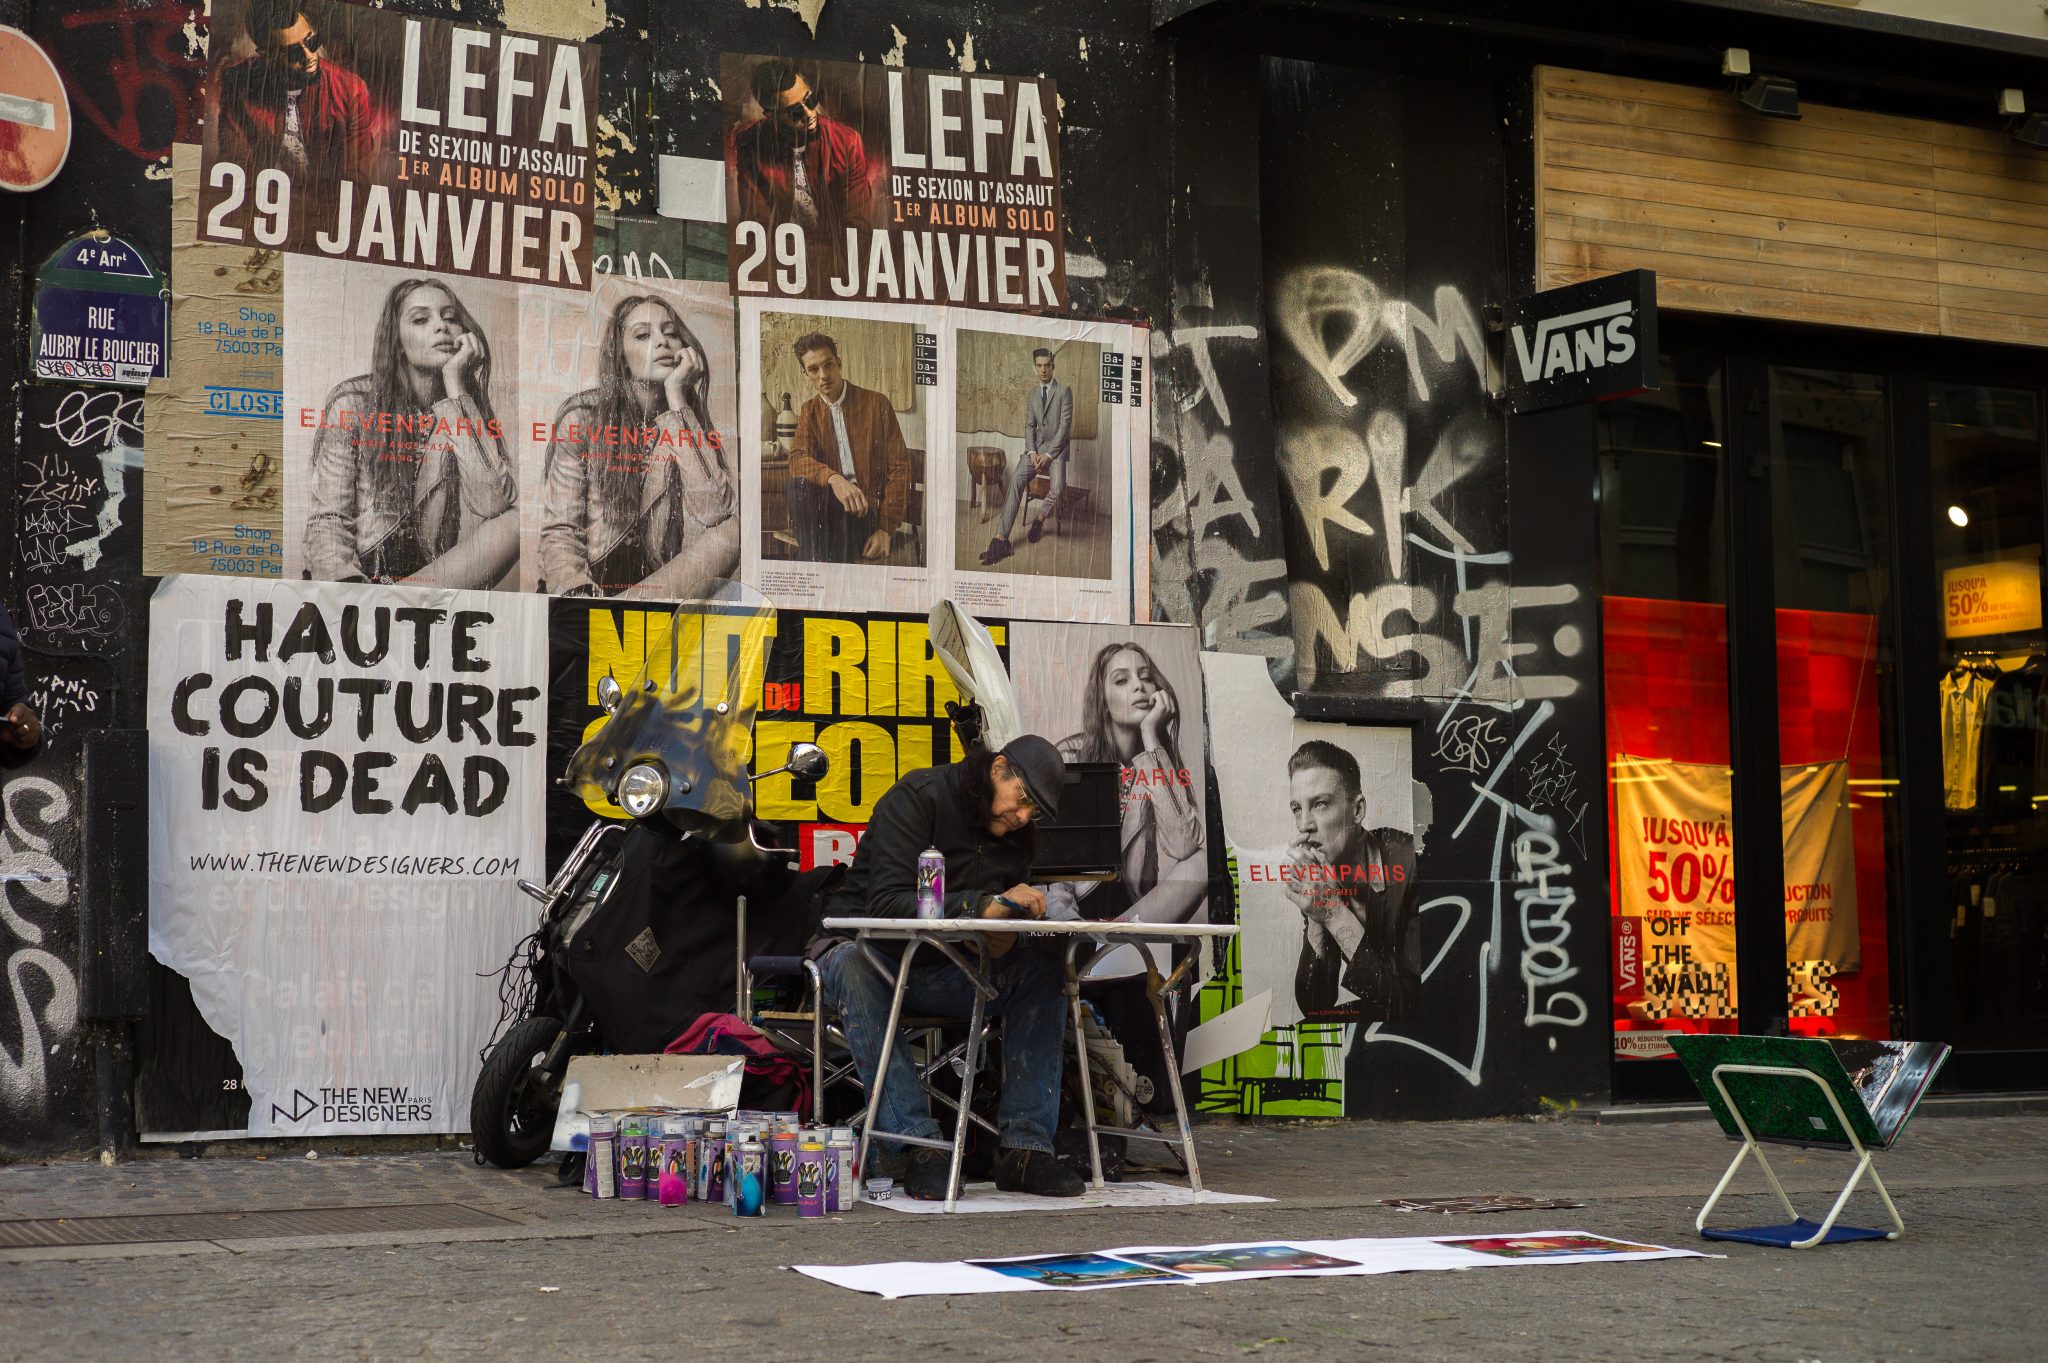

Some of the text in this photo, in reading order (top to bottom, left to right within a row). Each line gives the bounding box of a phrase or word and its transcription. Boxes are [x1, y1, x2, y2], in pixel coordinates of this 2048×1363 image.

[401, 19, 589, 148] LEFA
[887, 70, 1054, 178] LEFA
[399, 130, 422, 157] DE
[429, 133, 493, 166] SEXION
[439, 165, 519, 197] ALBUM
[530, 178, 586, 206] SOLO
[893, 175, 912, 198] DE
[917, 178, 973, 202] SEXION
[207, 162, 583, 285] 29 JANVIER
[930, 204, 997, 229] ALBUM
[1006, 209, 1055, 232] SOLO
[735, 220, 1059, 306] 29 JANVIER
[88, 306, 116, 331] RUE
[239, 307, 276, 325] Shop
[198, 322, 213, 335] 18
[218, 322, 246, 337] Rue
[252, 324, 269, 339] de
[1511, 300, 1637, 383] VANS
[40, 333, 160, 366] AUBRY LE BOUCHER
[215, 340, 260, 356] 75003
[209, 392, 284, 415] CLOSE
[300, 407, 503, 439] ELEVENPARIS
[532, 421, 722, 450] ELEVENPARIS
[234, 525, 272, 542] Shop
[192, 541, 208, 553] 18
[213, 541, 241, 556] Rue
[247, 543, 264, 557] de
[210, 558, 284, 575] 75003 Par
[1949, 592, 1989, 617] 50%
[225, 598, 494, 673] HAUTE
[171, 672, 541, 747] COUTURE
[765, 682, 800, 711] DU
[201, 747, 510, 817] IS DEAD
[190, 851, 520, 877] WWW.THENEWDESIGNERS.COM
[1249, 863, 1406, 882] ELEVENPARIS
[1646, 850, 1735, 905] 50%
[1652, 945, 1693, 965] THE
[223, 1079, 238, 1091] 28
[319, 1086, 408, 1105] THE NEW
[323, 1104, 433, 1124] DESIGNERS
[408, 1096, 433, 1105] PARIS
